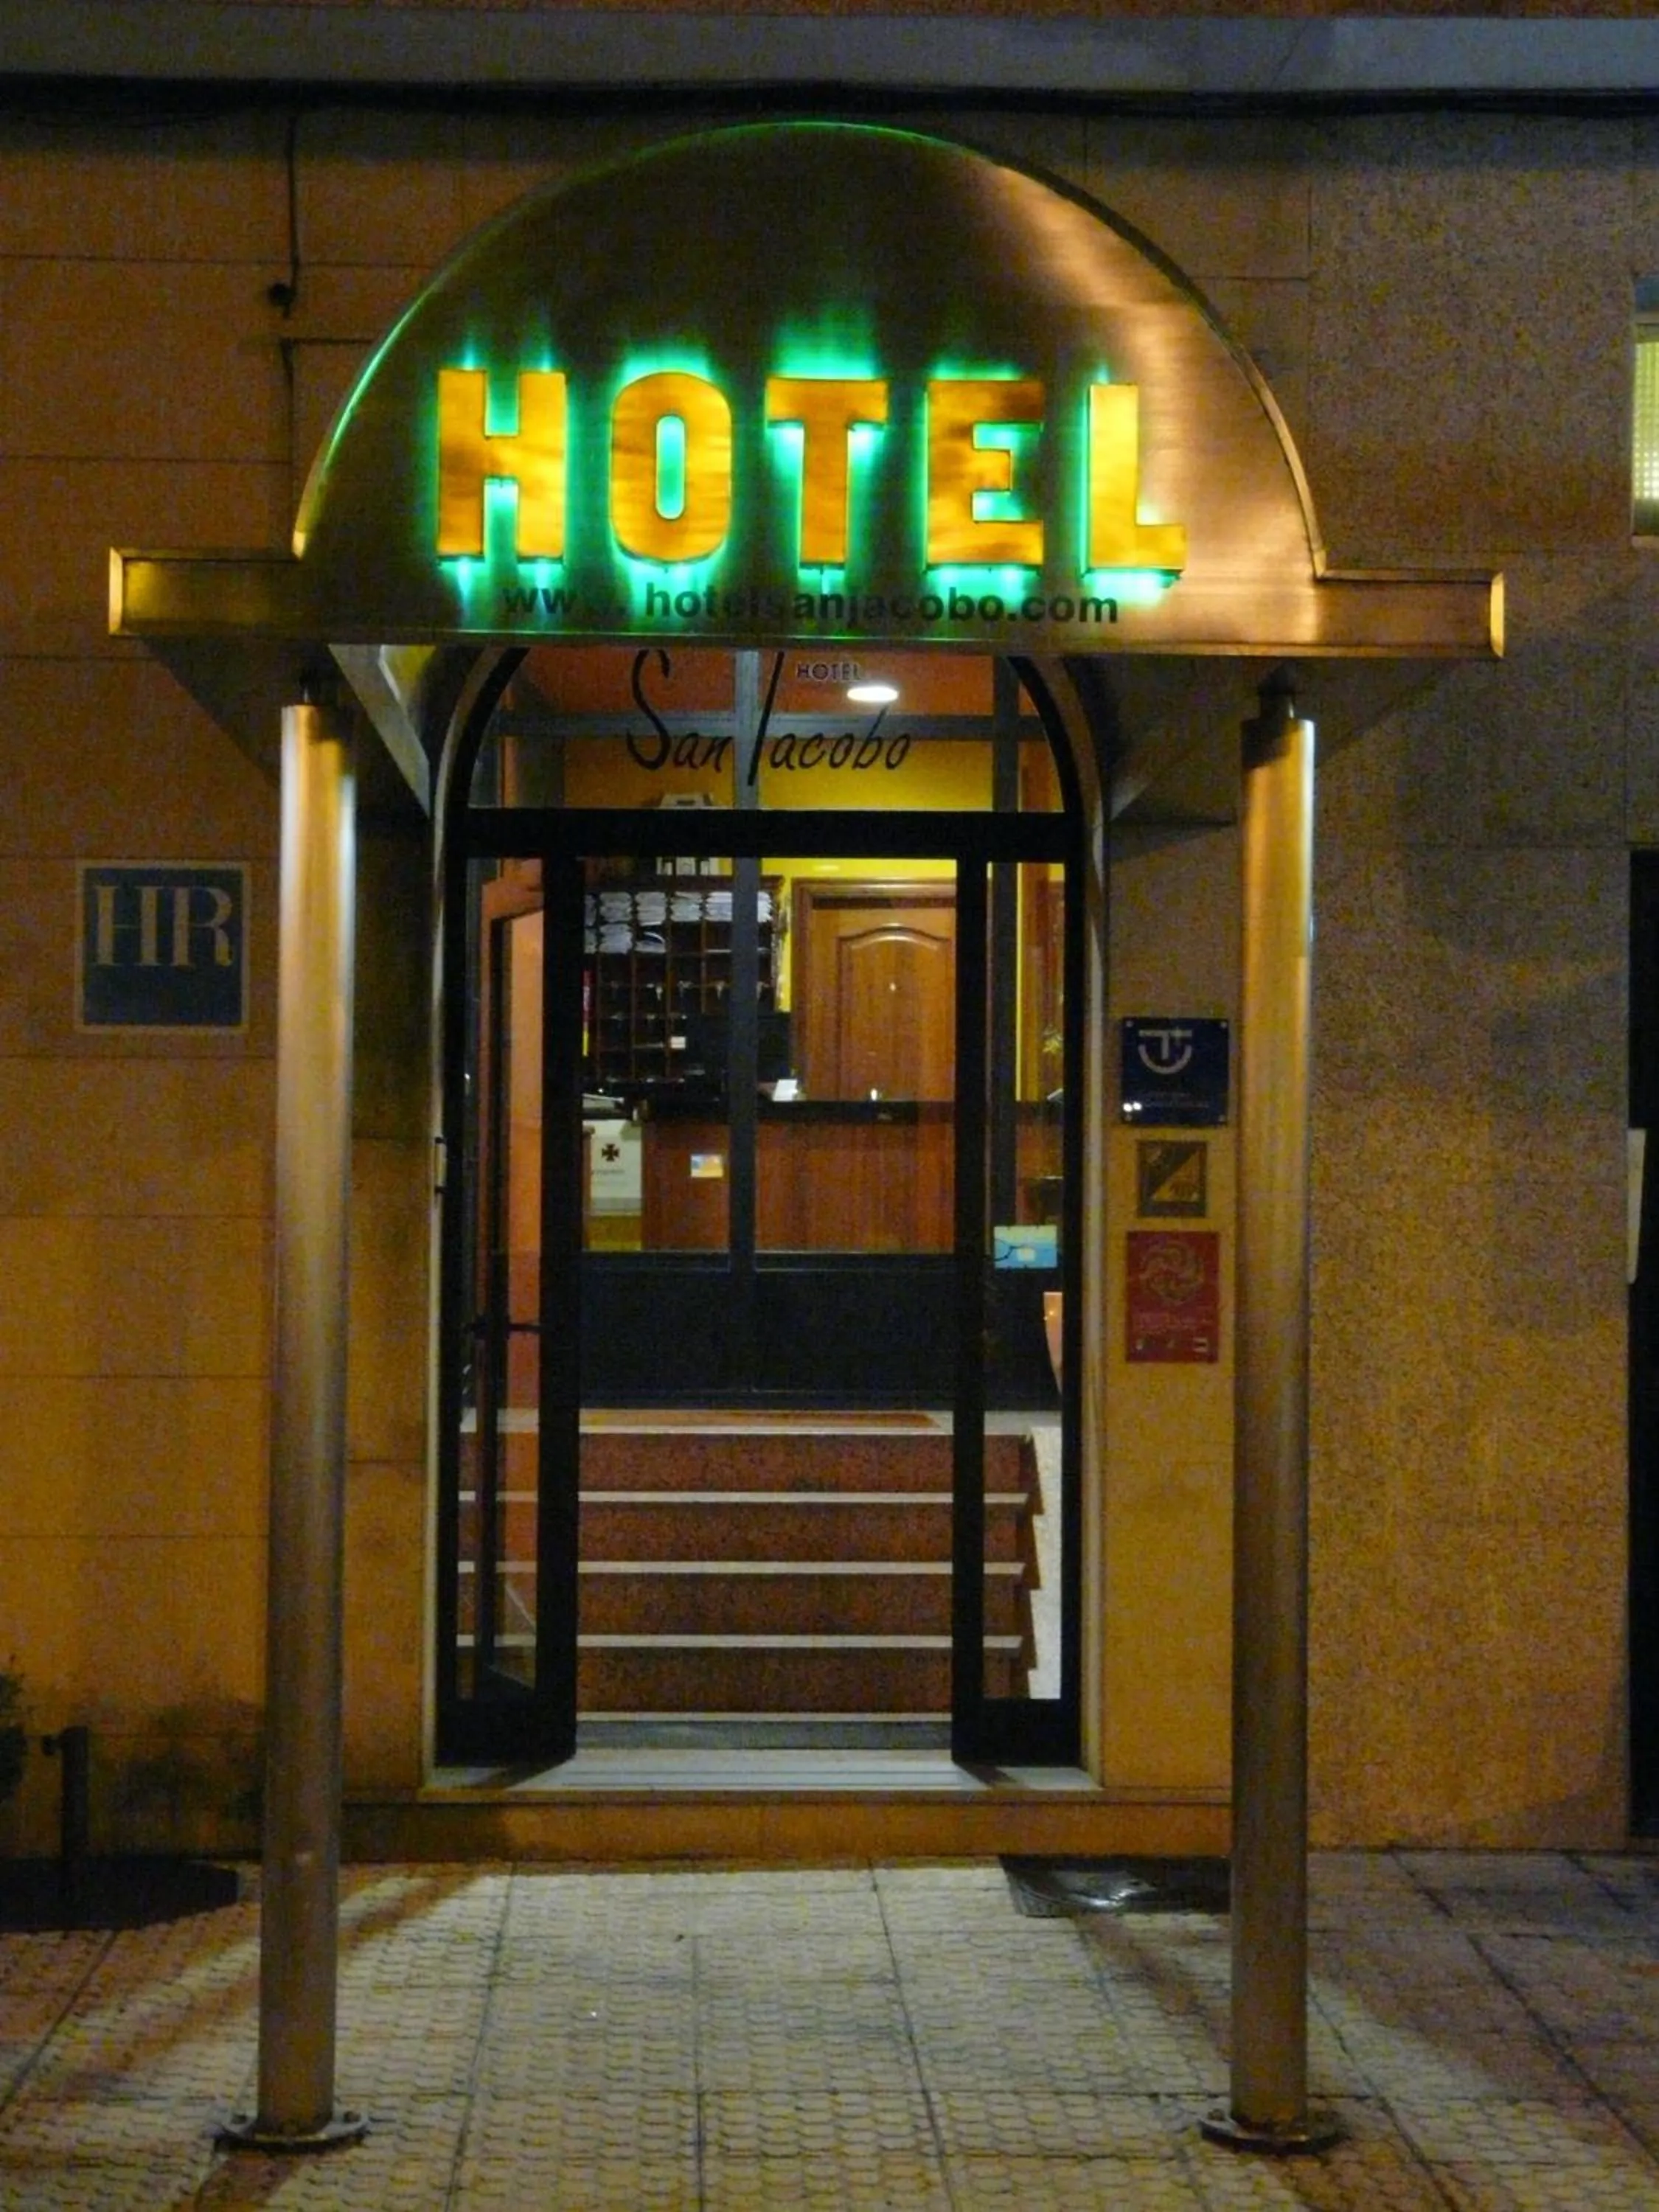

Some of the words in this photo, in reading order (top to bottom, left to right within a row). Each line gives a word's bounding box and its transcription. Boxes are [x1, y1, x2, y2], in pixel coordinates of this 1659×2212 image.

[437, 369, 1185, 573] HOTEL
[503, 582, 1119, 624] ww.hotelsanjacobo.com
[627, 649, 734, 771] San
[797, 664, 860, 681] HOTEL
